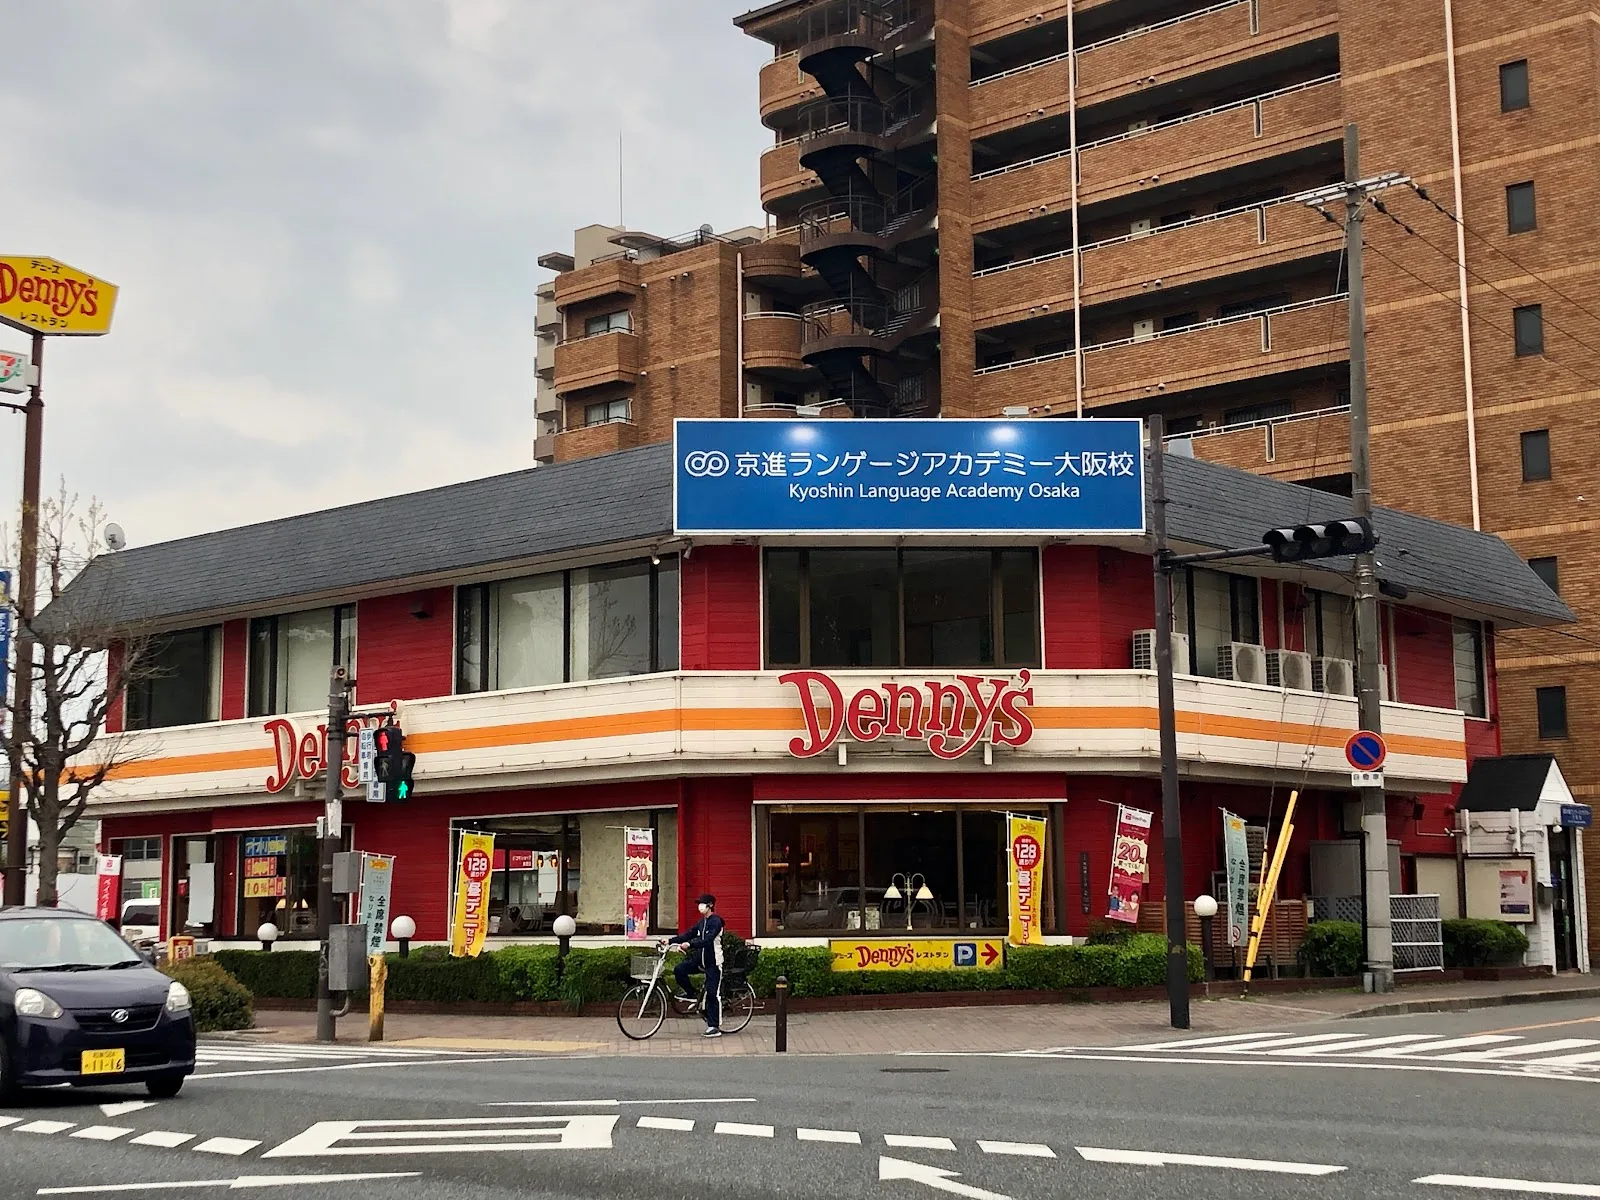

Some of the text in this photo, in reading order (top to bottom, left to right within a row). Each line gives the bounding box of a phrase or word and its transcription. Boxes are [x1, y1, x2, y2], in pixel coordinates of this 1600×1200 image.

[0, 262, 98, 317] Denny's
[734, 450, 1135, 478] 京進ランゲージアカデミー大阪校
[788, 482, 1080, 502] Kyoshin Language Academy Osaka
[778, 669, 1034, 759] Denny's
[1014, 843, 1037, 859] 128
[467, 857, 488, 872] 128
[855, 944, 914, 968] Denny's
